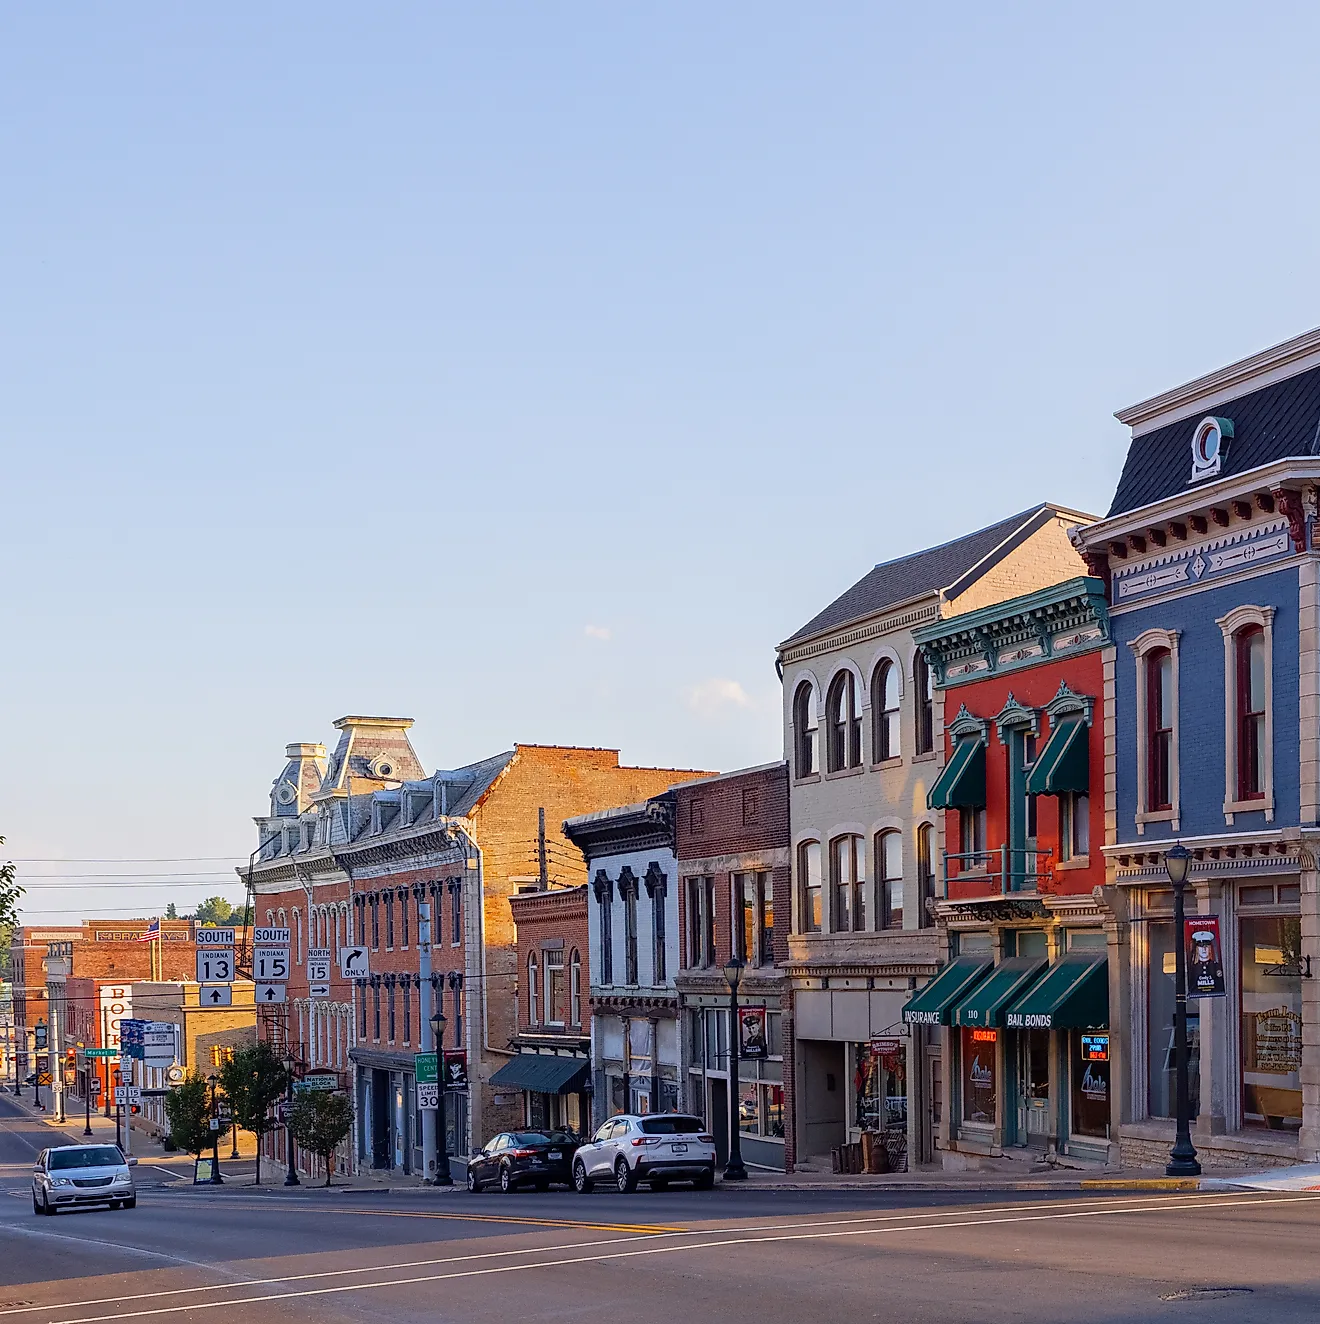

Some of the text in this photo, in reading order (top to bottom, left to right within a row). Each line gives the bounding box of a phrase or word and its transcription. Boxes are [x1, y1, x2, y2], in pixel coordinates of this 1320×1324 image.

[112, 932, 172, 940] BRAY
[198, 932, 232, 942] SOUTH
[256, 930, 289, 940] SOUTH
[204, 960, 229, 979] 13
[259, 959, 286, 977] 15
[311, 966, 326, 979] 15
[904, 1011, 940, 1024] INSURANCE
[968, 1010, 978, 1019] 110
[1008, 1014, 1051, 1026] BAIL BONDS
[1282, 1006, 1302, 1024] Law
[974, 1065, 992, 1079] Dale
[1086, 1075, 1106, 1091] Dale
[420, 1096, 438, 1107] 30
